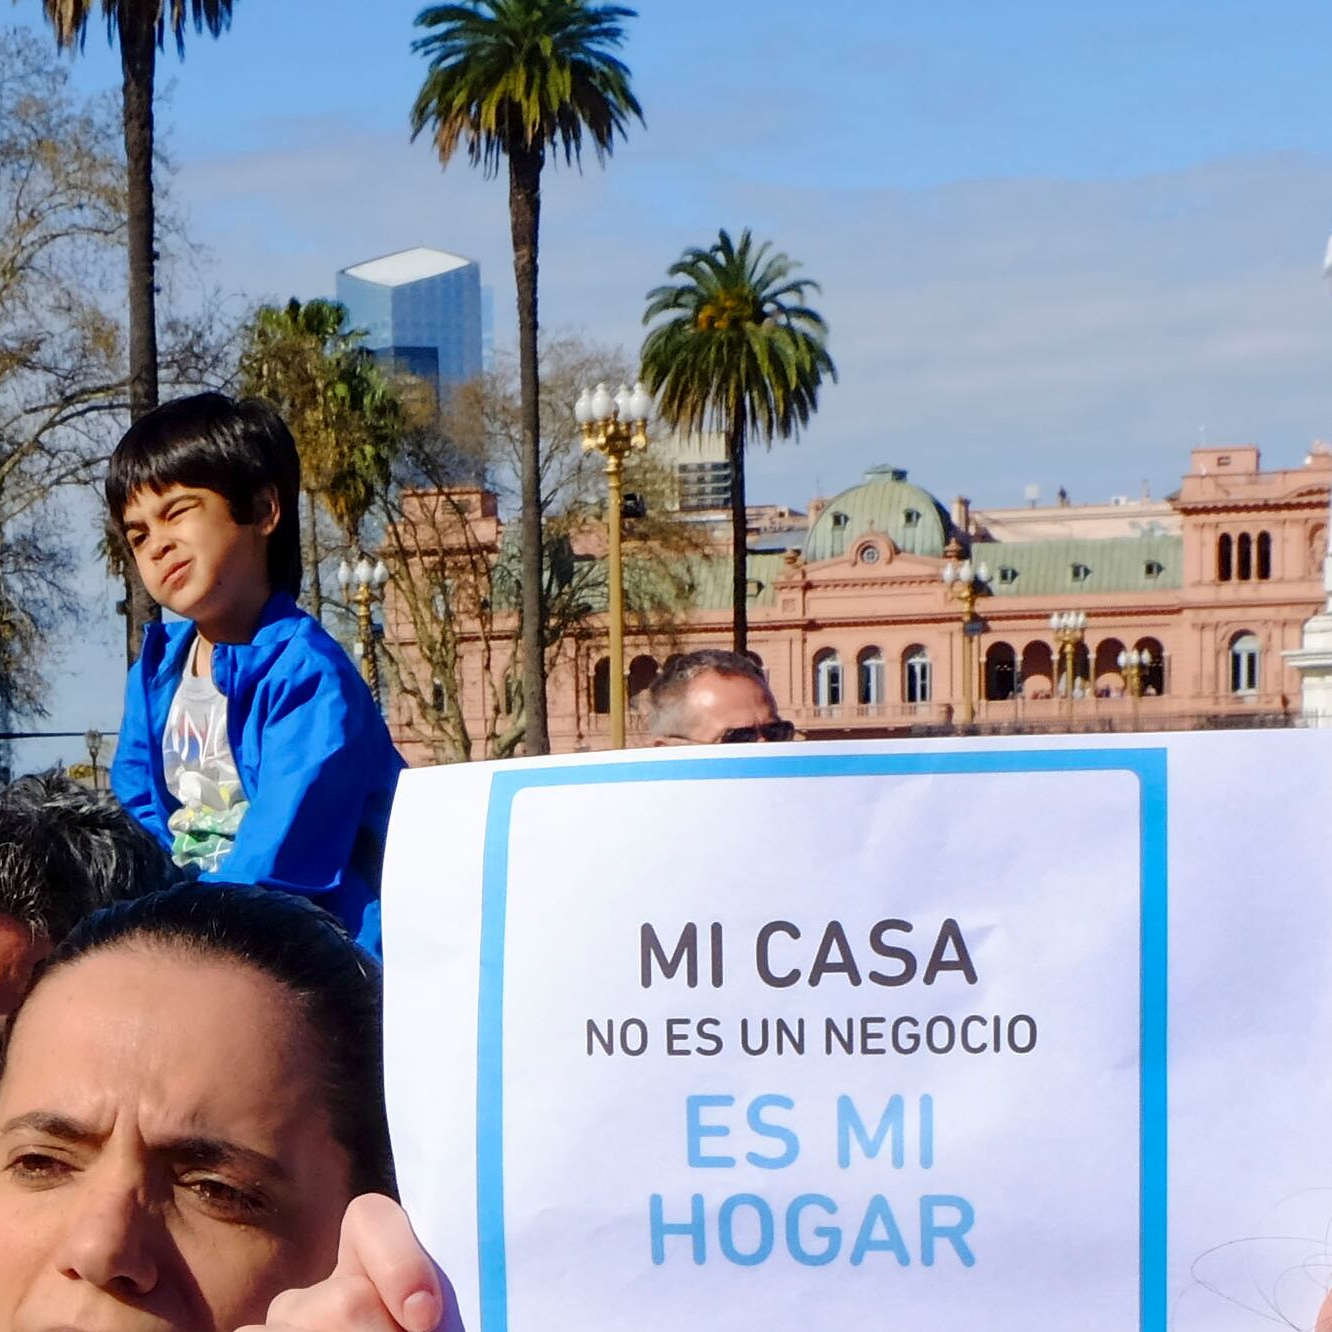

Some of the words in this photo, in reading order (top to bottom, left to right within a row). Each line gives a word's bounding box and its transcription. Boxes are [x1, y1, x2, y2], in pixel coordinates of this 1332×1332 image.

[641, 921, 724, 989] MI
[755, 918, 979, 989] CASA
[586, 1017, 649, 1057] NO
[667, 1017, 724, 1057] ES
[740, 1017, 805, 1057] UN
[824, 1014, 1038, 1056] NEGOCIO
[685, 1093, 801, 1170] ES
[836, 1093, 934, 1170] MI
[649, 1193, 976, 1268] HOGAR
